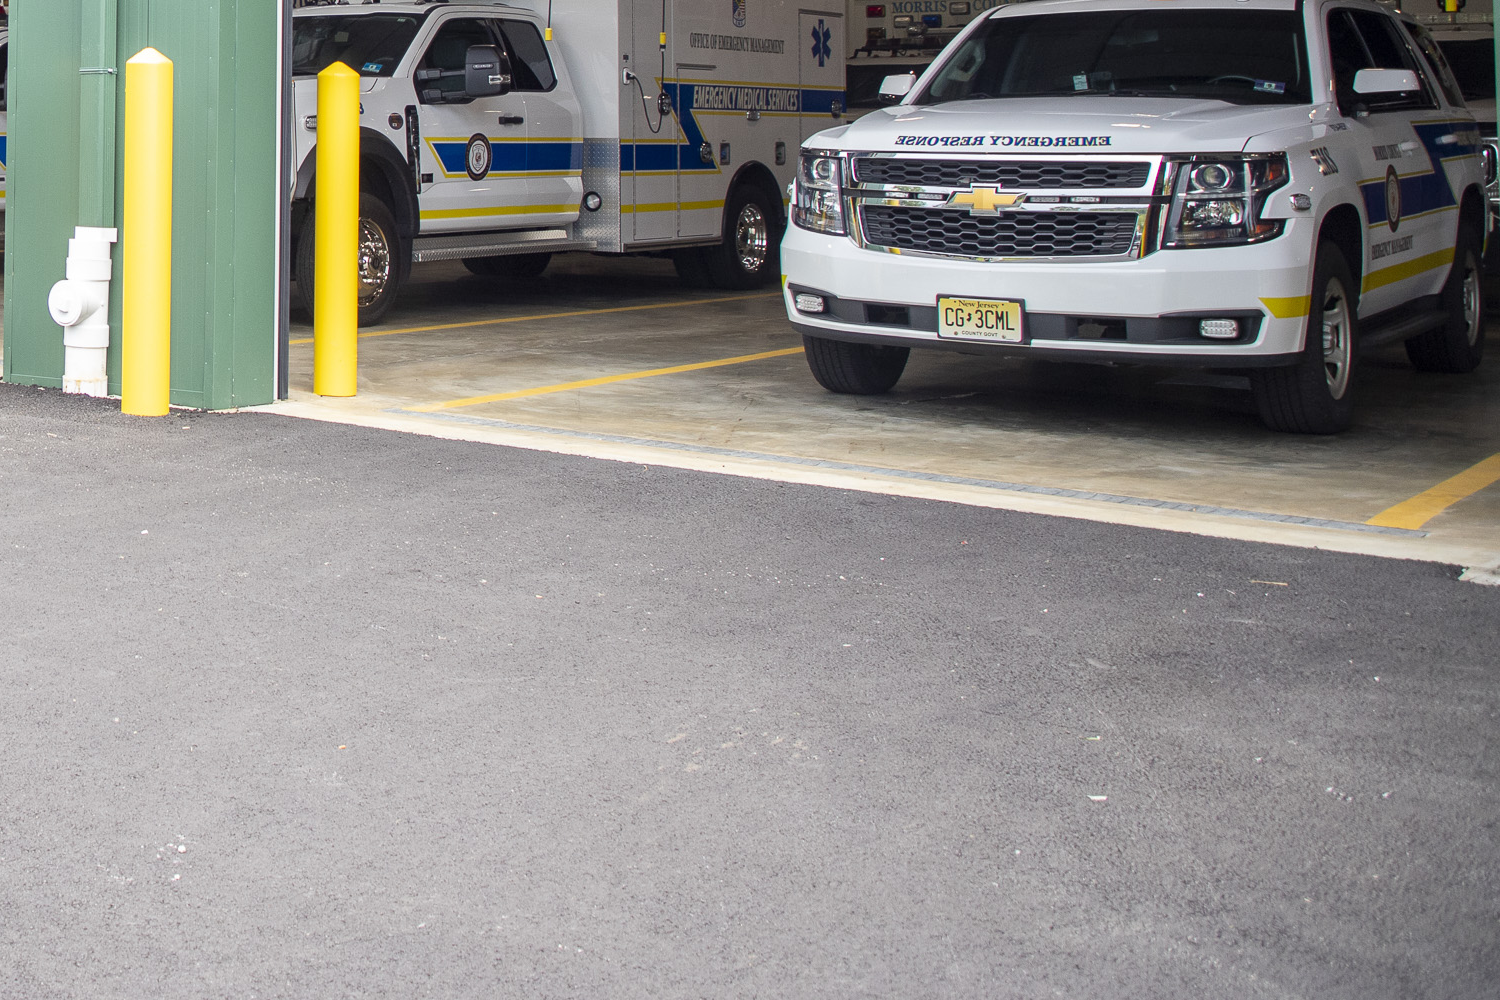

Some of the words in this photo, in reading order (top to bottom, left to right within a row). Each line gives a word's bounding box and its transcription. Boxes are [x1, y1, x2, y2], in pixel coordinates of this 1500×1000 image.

[891, 1, 947, 15] MORRIS
[689, 32, 709, 49] OFFICE
[710, 34, 718, 50] OF
[718, 35, 750, 53] EMERGENCY
[750, 37, 785, 54] MANAGEMENT
[693, 85, 737, 110] EMERGENCY
[737, 87, 767, 110] MEDICAL
[768, 89, 799, 111] SERVICES
[976, 301, 999, 309] Jersey
[945, 307, 965, 328] CG
[975, 309, 1015, 331] 3CML
